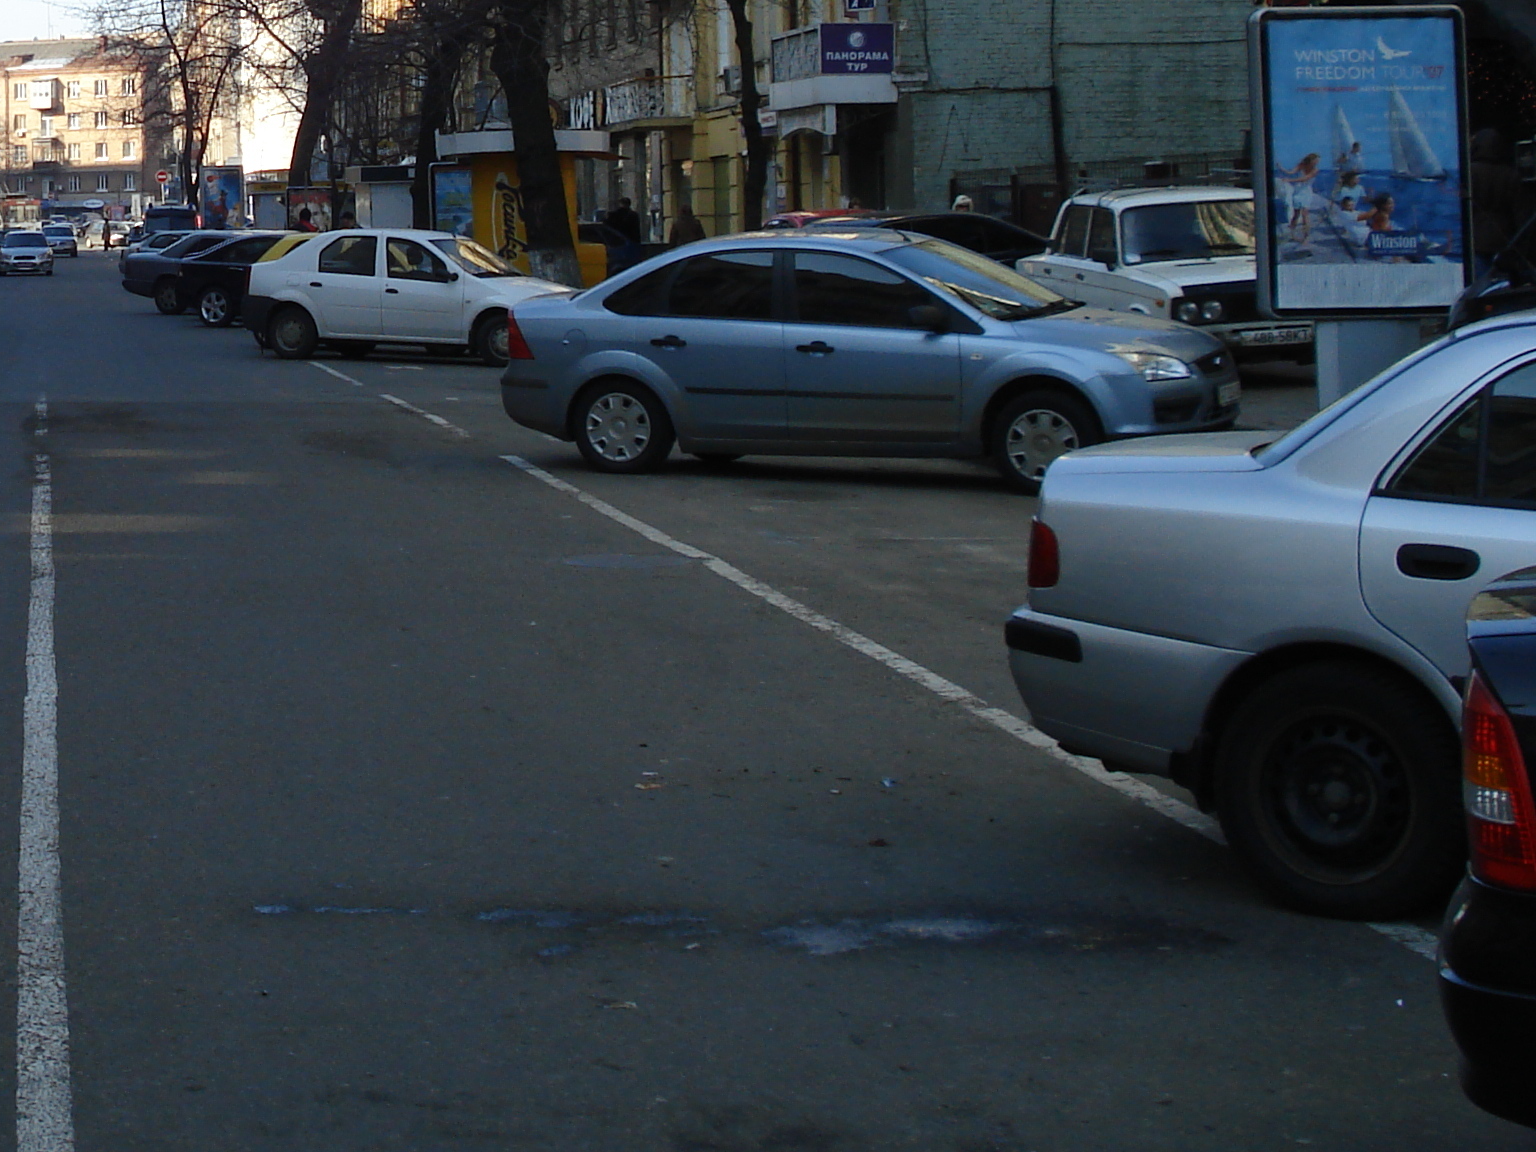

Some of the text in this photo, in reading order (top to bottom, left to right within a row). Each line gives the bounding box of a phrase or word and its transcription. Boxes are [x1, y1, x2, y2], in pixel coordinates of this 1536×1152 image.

[826, 51, 889, 61] ПАНОРАМА
[1294, 48, 1376, 63] WINSTON
[846, 62, 868, 71] ТУР
[1296, 66, 1376, 80] FREEDOM
[1371, 233, 1418, 249] Winston
